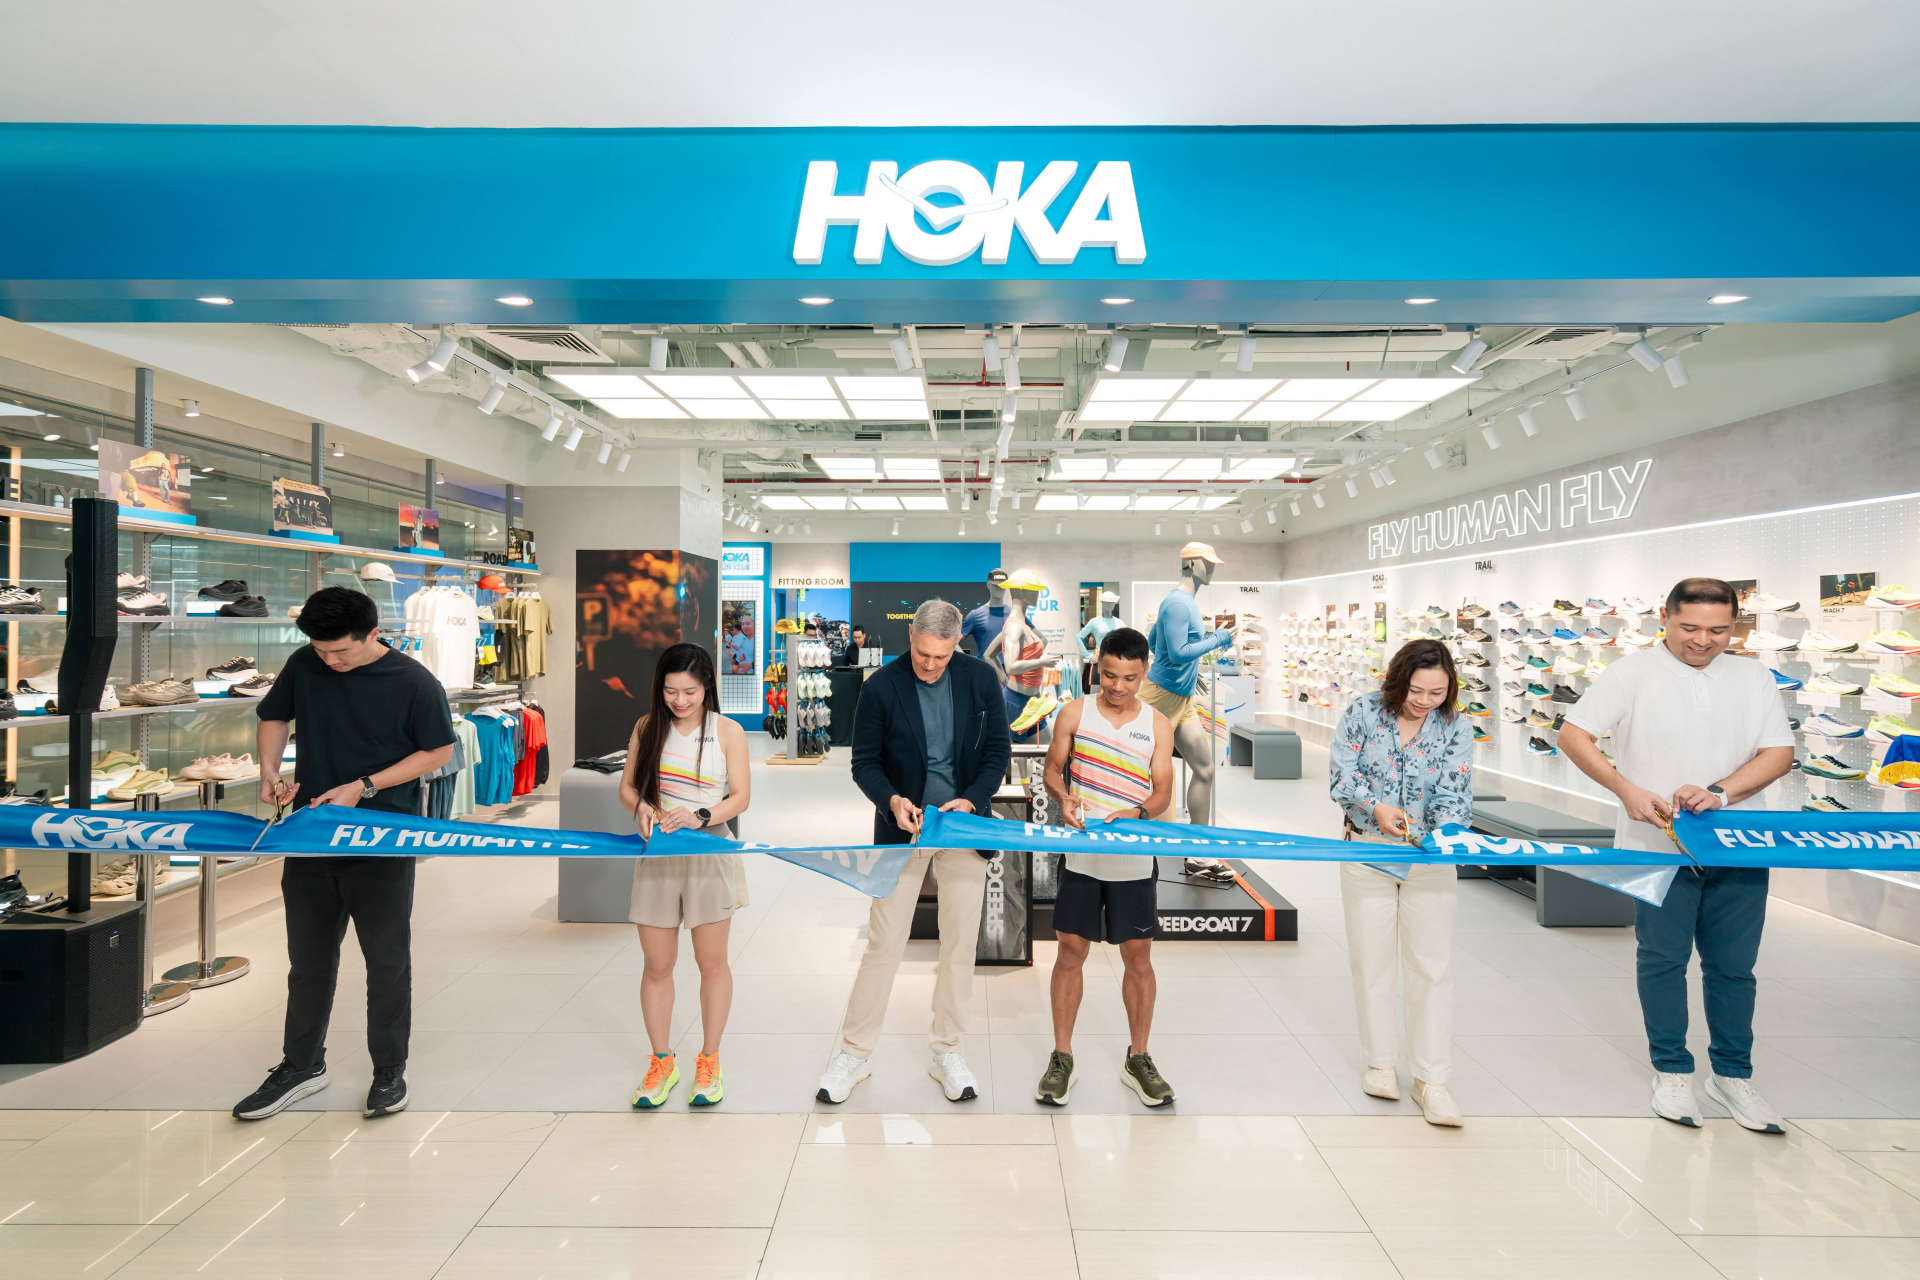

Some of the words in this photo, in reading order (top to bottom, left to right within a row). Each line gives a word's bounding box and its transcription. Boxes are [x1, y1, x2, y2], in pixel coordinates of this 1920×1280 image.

[793, 160, 1147, 266] HOKA
[1368, 518, 1409, 560] FLY
[1412, 483, 1551, 554] HUMAN
[1560, 458, 1653, 529] FLY
[483, 551, 507, 566] ROAD
[1475, 560, 1493, 571] TRAIL
[778, 578, 812, 586] FITTING
[814, 578, 844, 586] ROOM
[446, 615, 467, 627] HOKA
[1129, 731, 1151, 742] HOKA
[31, 812, 195, 850] HOKA
[329, 824, 393, 847] FLY
[1713, 828, 1776, 849] FLY
[1241, 916, 1254, 932] 7
